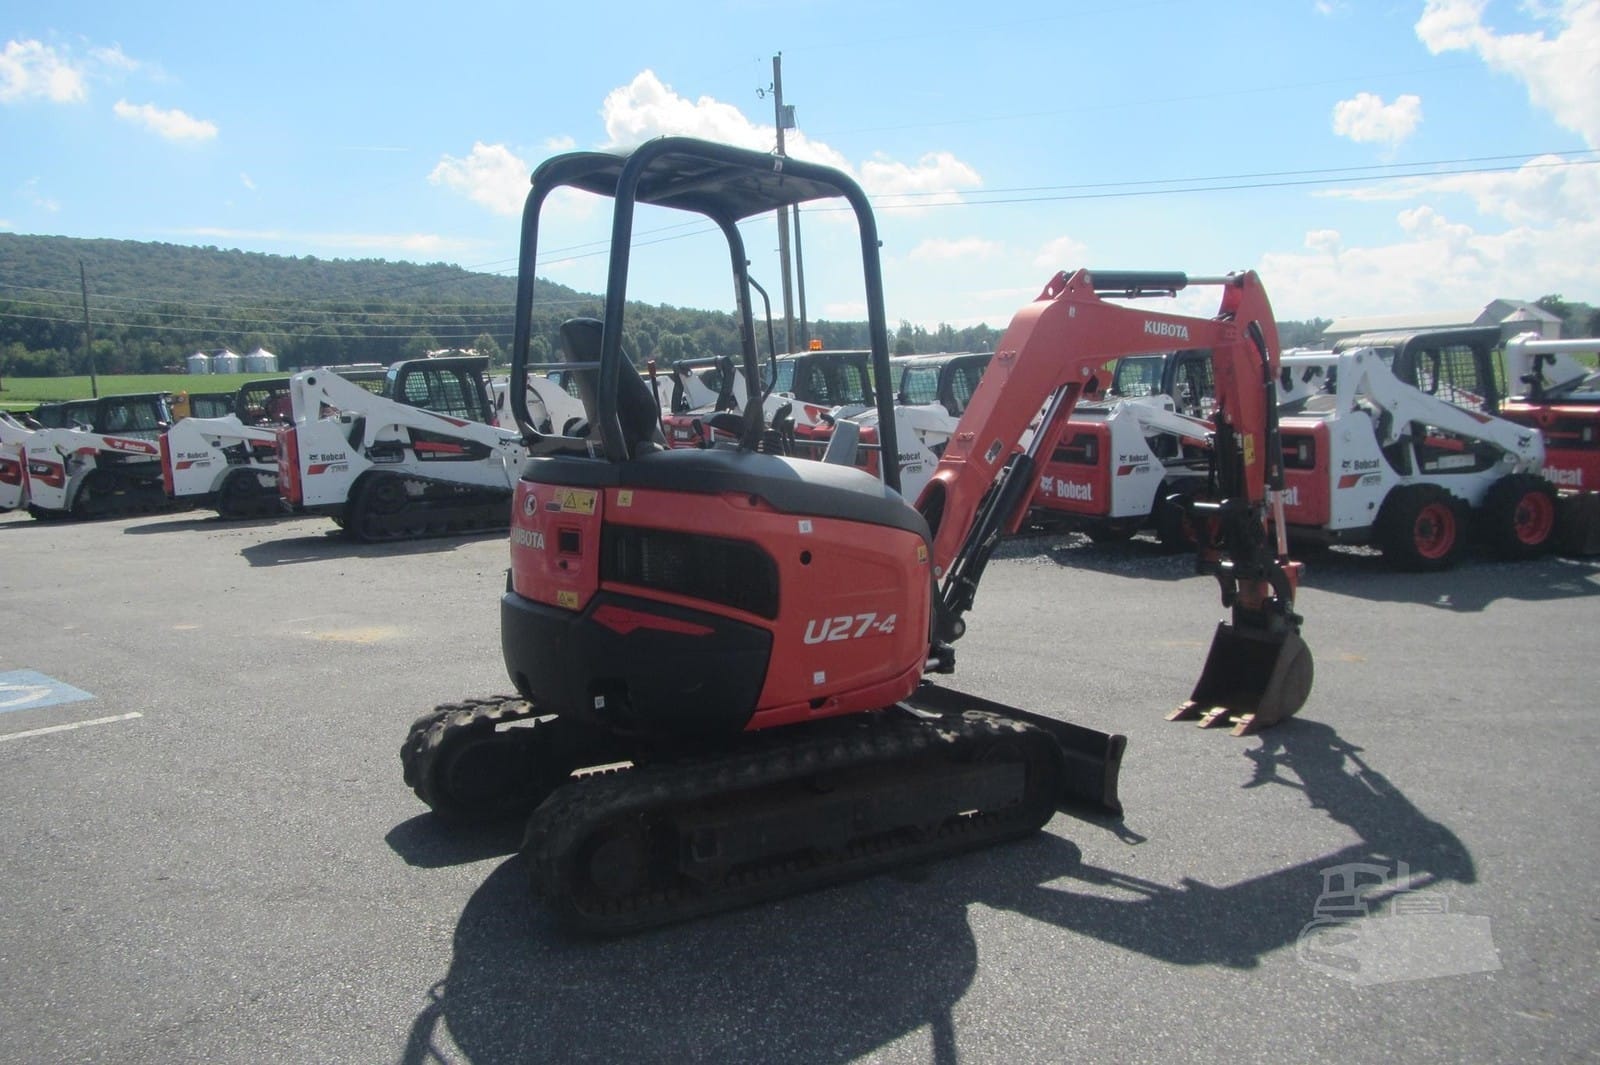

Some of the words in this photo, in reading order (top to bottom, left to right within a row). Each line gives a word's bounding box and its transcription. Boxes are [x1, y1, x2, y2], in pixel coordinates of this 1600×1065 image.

[1144, 320, 1190, 341] KUBOTA
[187, 451, 209, 459] Bobcat
[320, 452, 346, 462] Bobcat
[1129, 453, 1149, 463] Bobcat
[1353, 458, 1379, 471] Bobcat
[1541, 465, 1582, 486] obcat
[1057, 479, 1092, 501] Bobcat
[803, 612, 897, 645] U27-4
